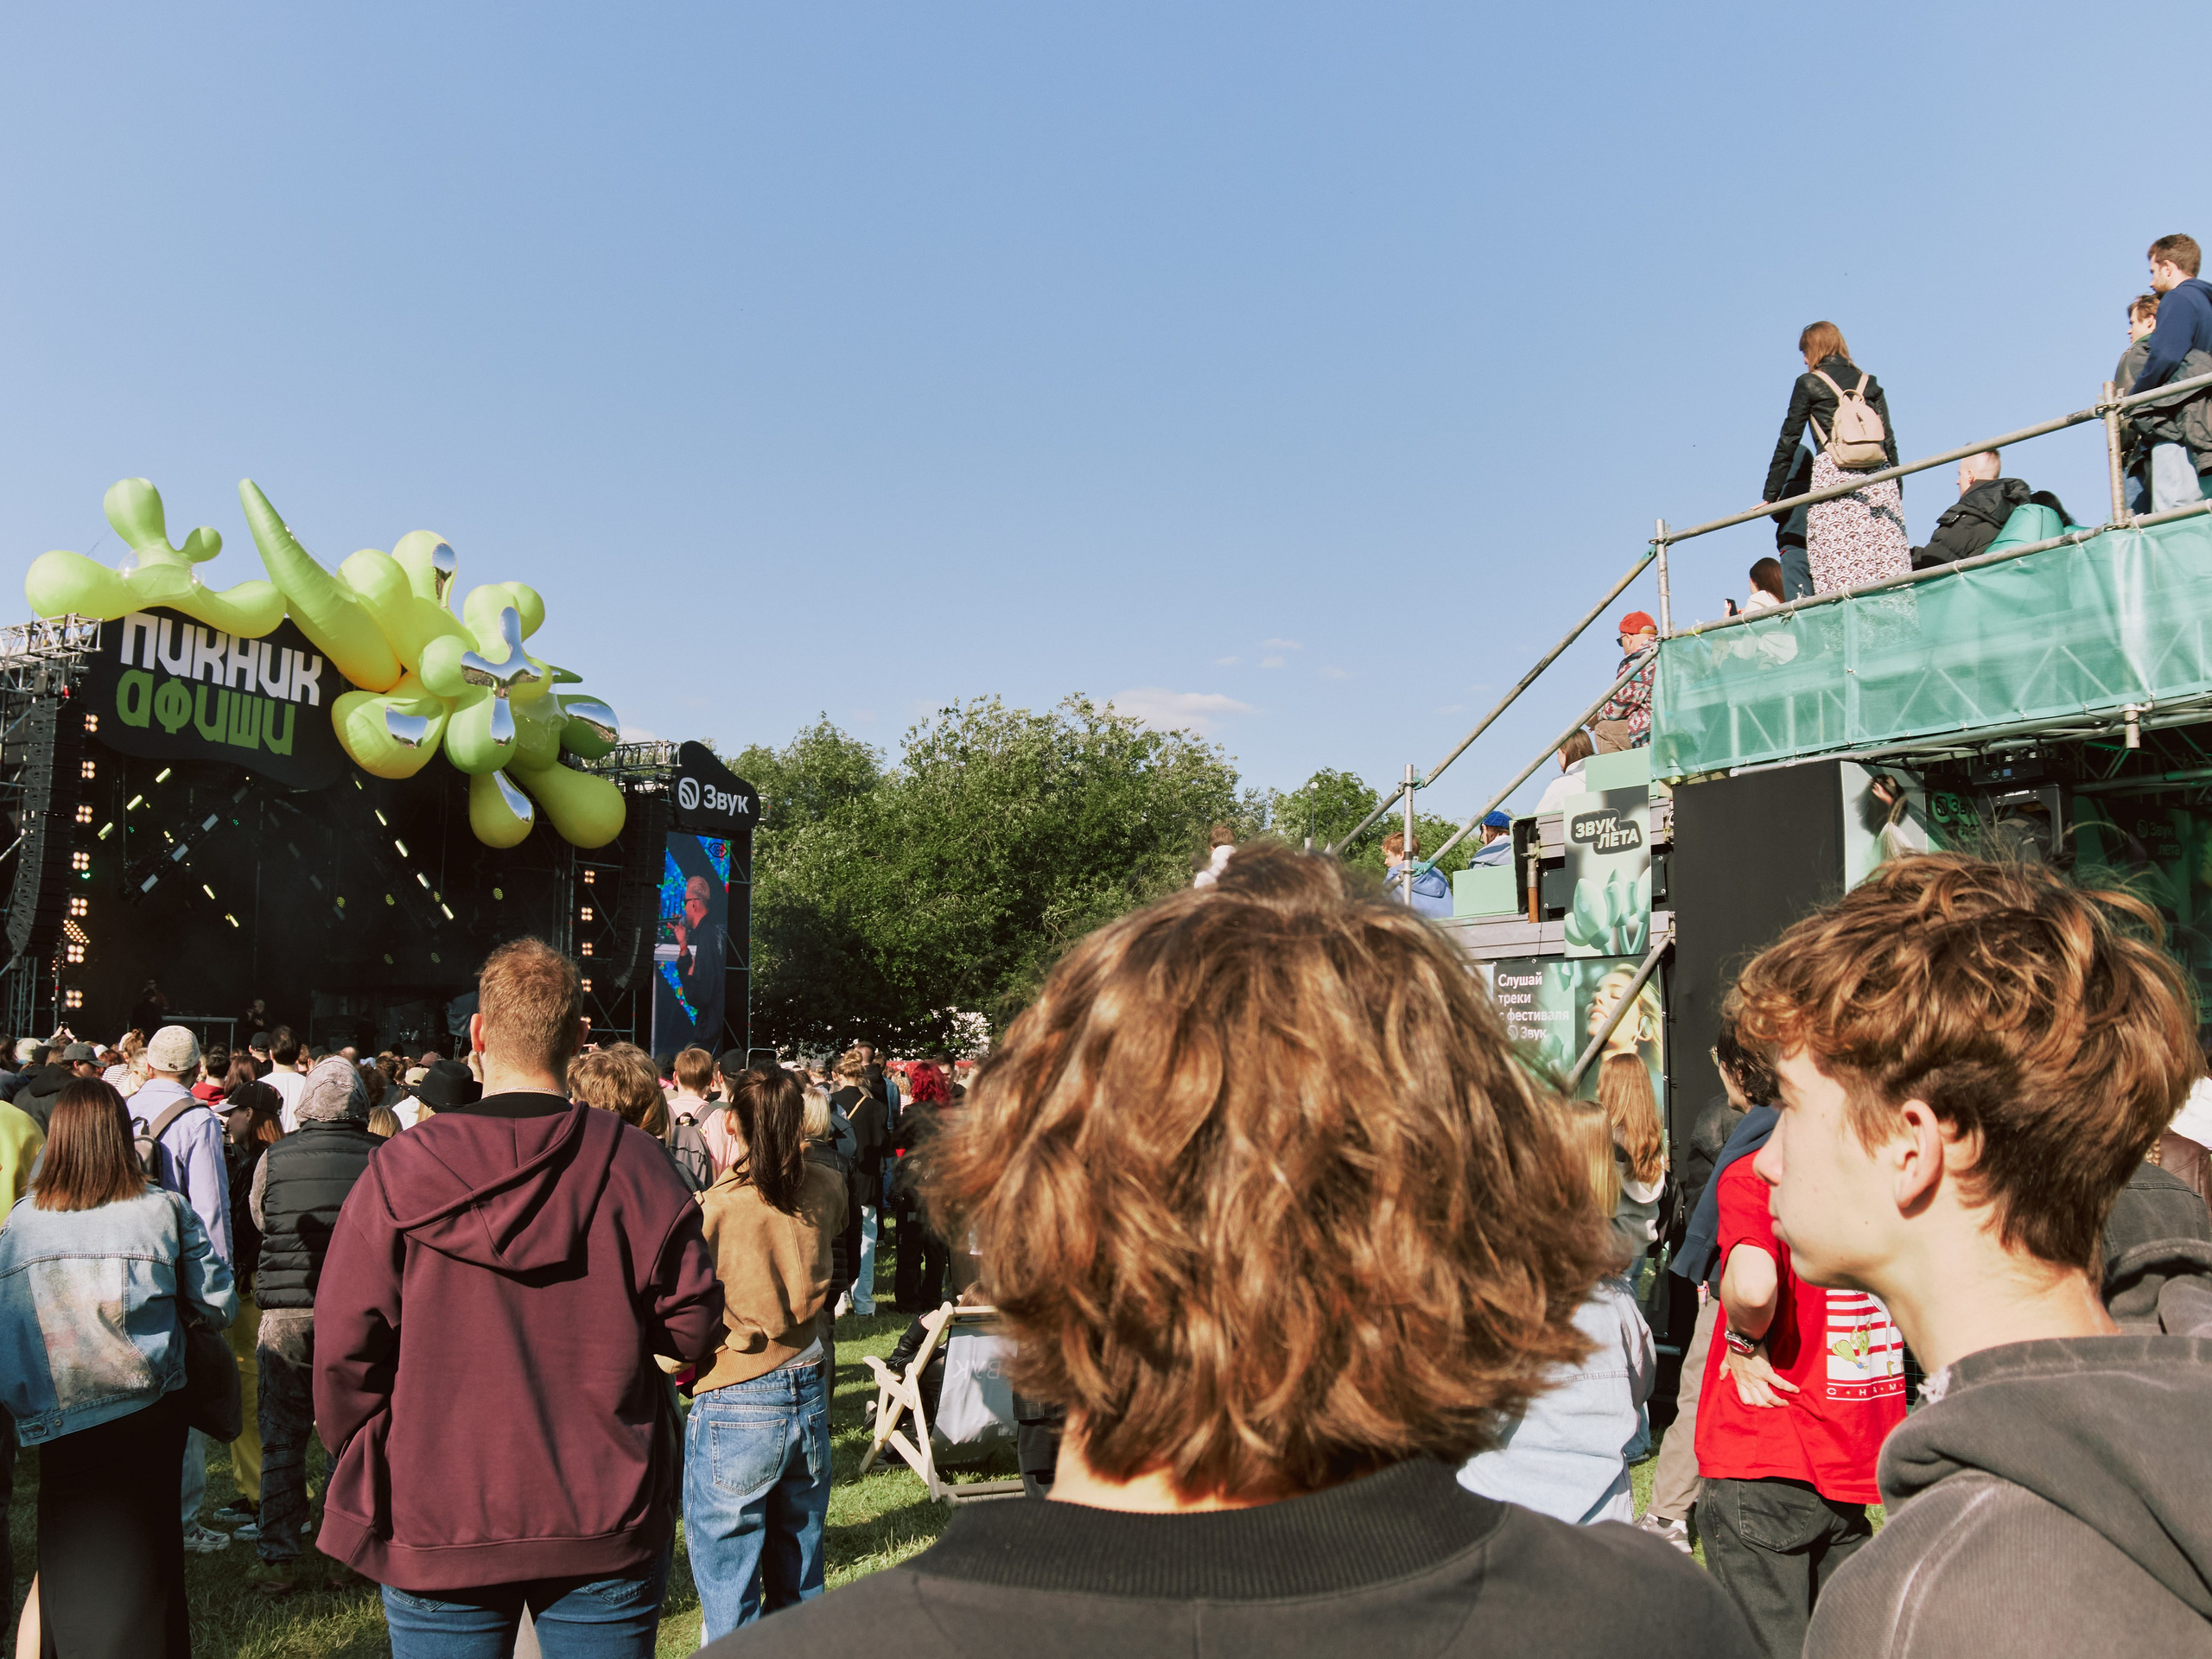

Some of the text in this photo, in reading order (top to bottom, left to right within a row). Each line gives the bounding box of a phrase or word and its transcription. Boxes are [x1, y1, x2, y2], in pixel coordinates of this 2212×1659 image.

[703, 784, 749, 817] Звук
[1574, 817, 1618, 839] ЗВУК
[1598, 828, 1640, 850] ЛЕТА
[1497, 971, 1542, 989] Слушай
[1497, 993, 1531, 1007] треки
[1507, 1007, 1570, 1024] фестиваля
[1521, 1026, 1548, 1041] Звук
